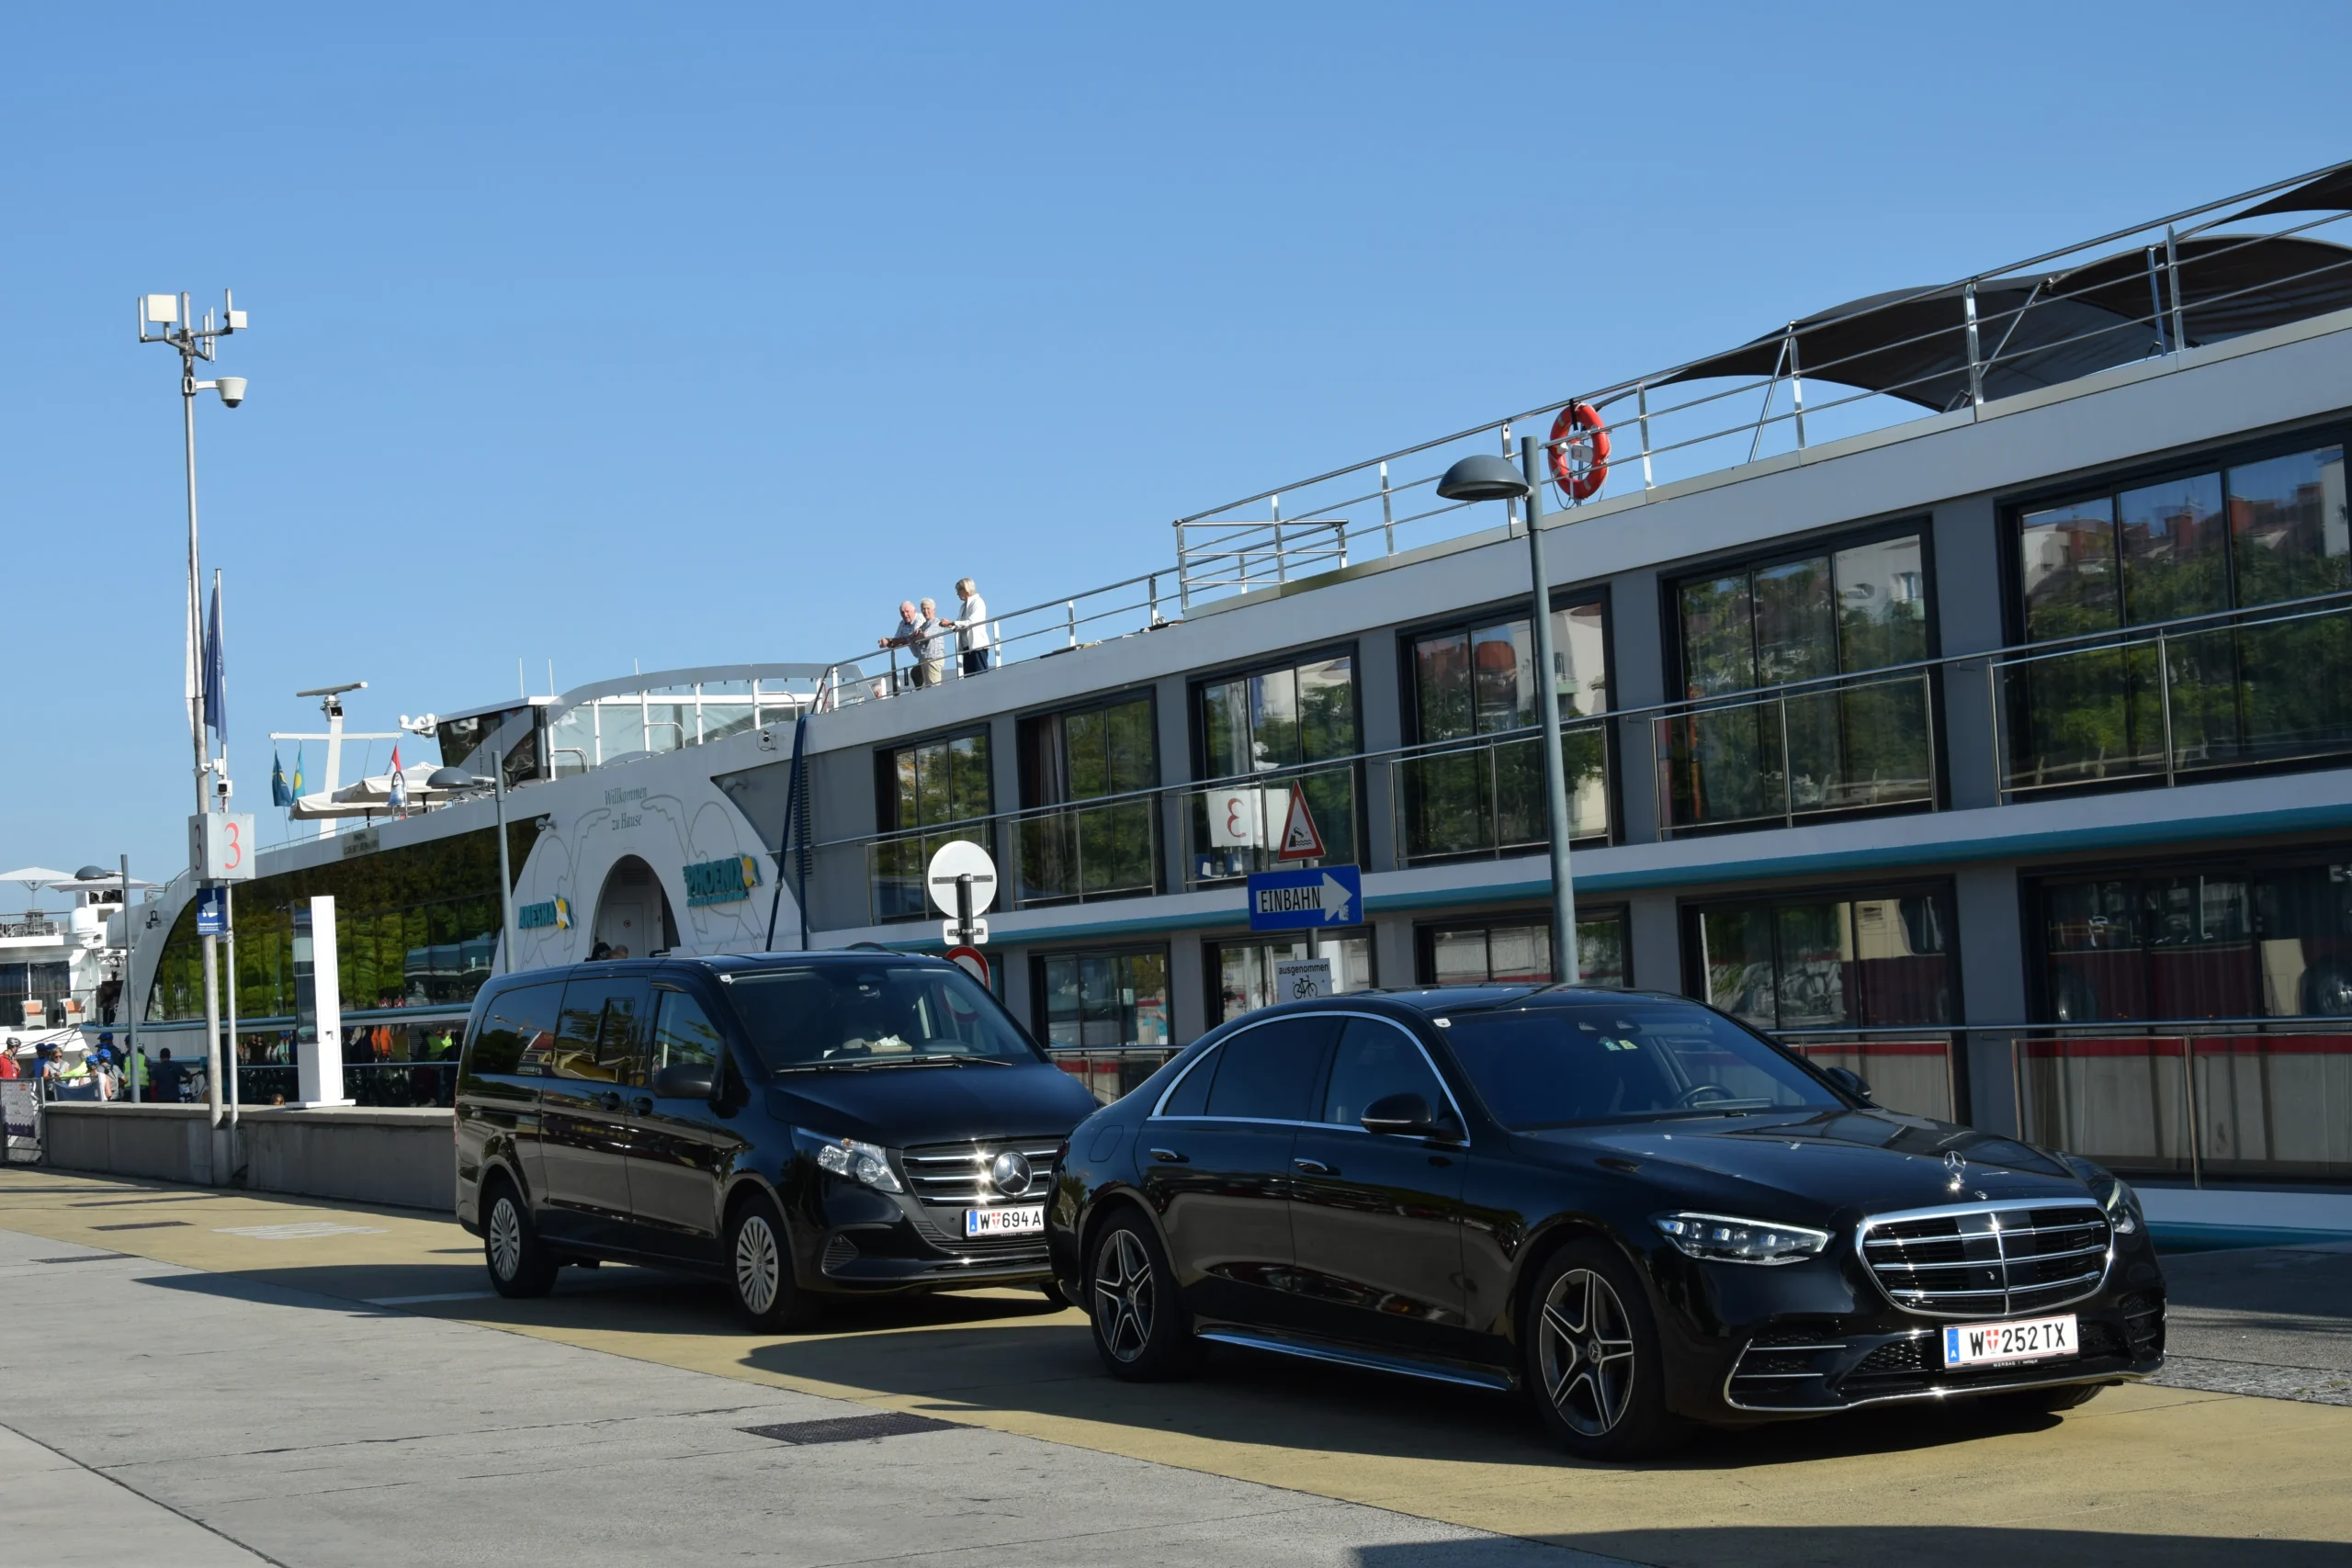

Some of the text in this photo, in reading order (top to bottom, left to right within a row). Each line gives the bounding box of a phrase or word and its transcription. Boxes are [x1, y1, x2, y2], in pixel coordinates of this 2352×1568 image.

[605, 787, 647, 806] Willkommen
[621, 813, 642, 829] Hause
[194, 823, 202, 871] 3
[224, 822, 242, 870] 3
[683, 857, 744, 897] PHOENIX
[1261, 886, 1321, 912] EINBAHN
[518, 900, 557, 930] ANESHA
[1278, 964, 1329, 976] ausgenommen
[979, 1211, 1041, 1230] W 694 A
[1970, 1323, 2065, 1357] W 252 TX
[1951, 1349, 1957, 1358] A
